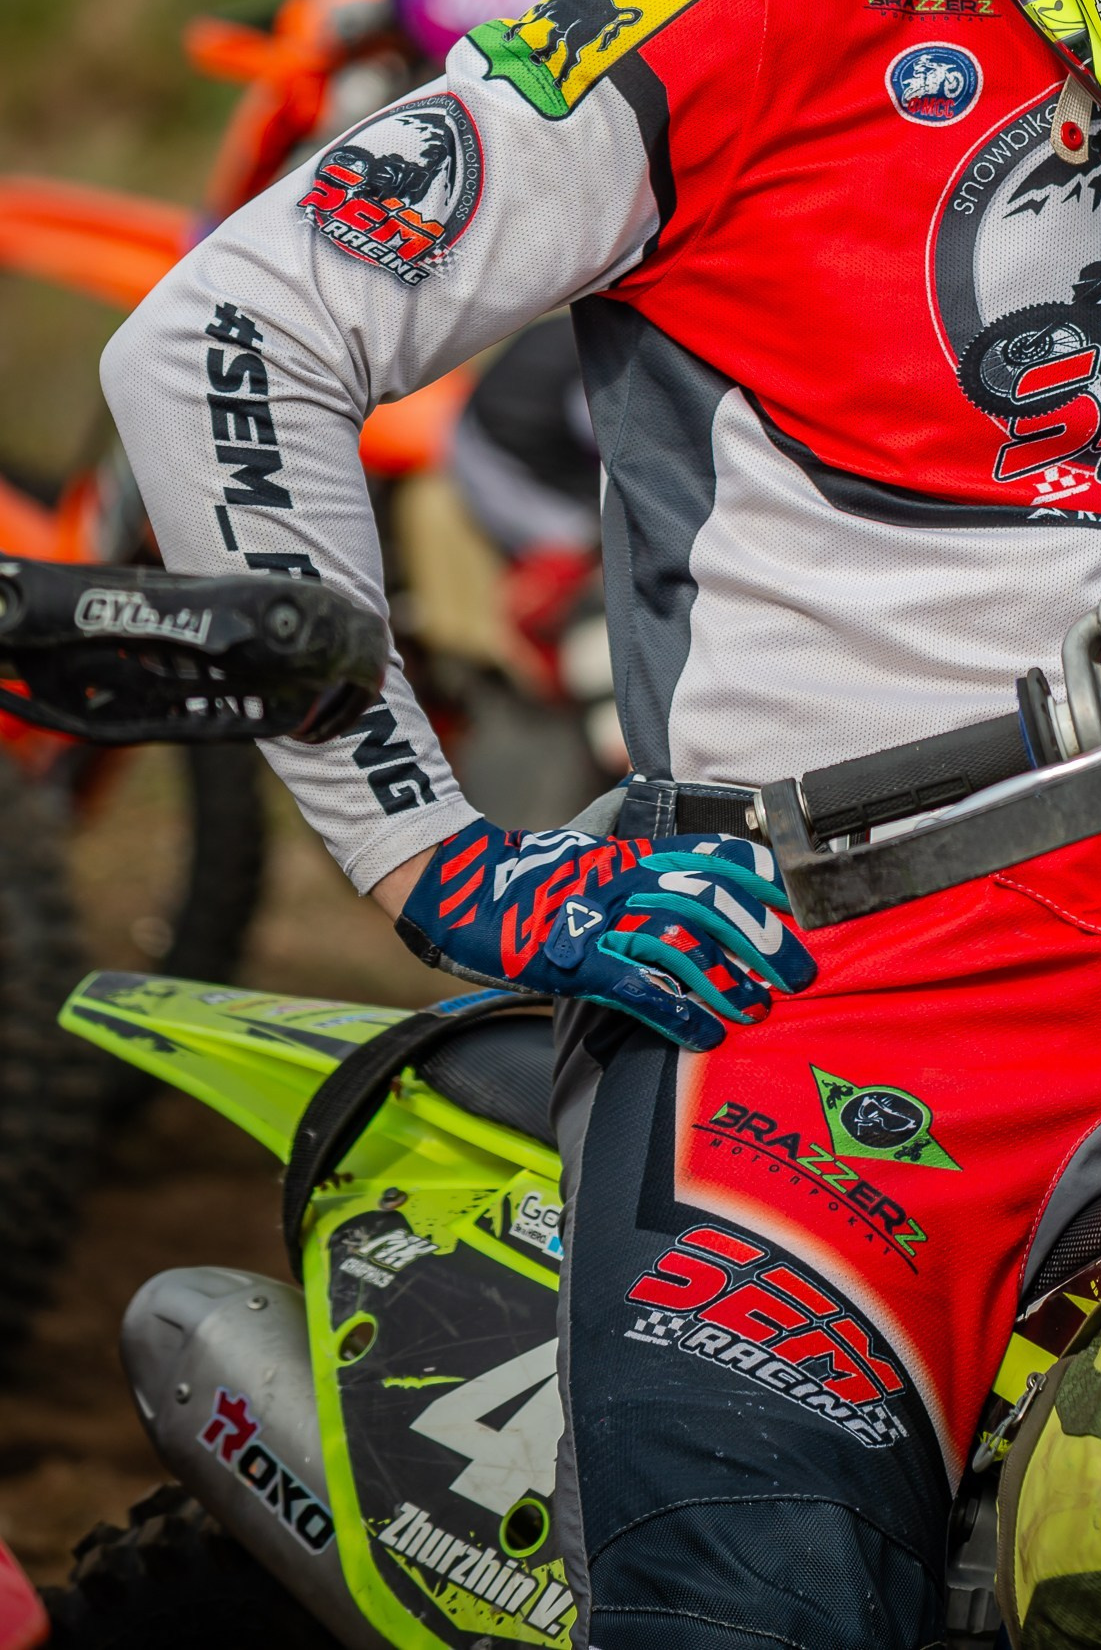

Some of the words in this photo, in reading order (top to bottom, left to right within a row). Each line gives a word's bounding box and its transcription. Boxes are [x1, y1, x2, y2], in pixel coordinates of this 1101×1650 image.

[455, 134, 480, 222] motocross
[952, 102, 1058, 217] snowbike
[319, 218, 431, 287] RACING
[709, 1101, 929, 1257] BRAZZERZ
[624, 1223, 908, 1407] SEM
[678, 1324, 898, 1449] RACING
[378, 1502, 539, 1616] Zhurzhin
[529, 1581, 576, 1637] V.
